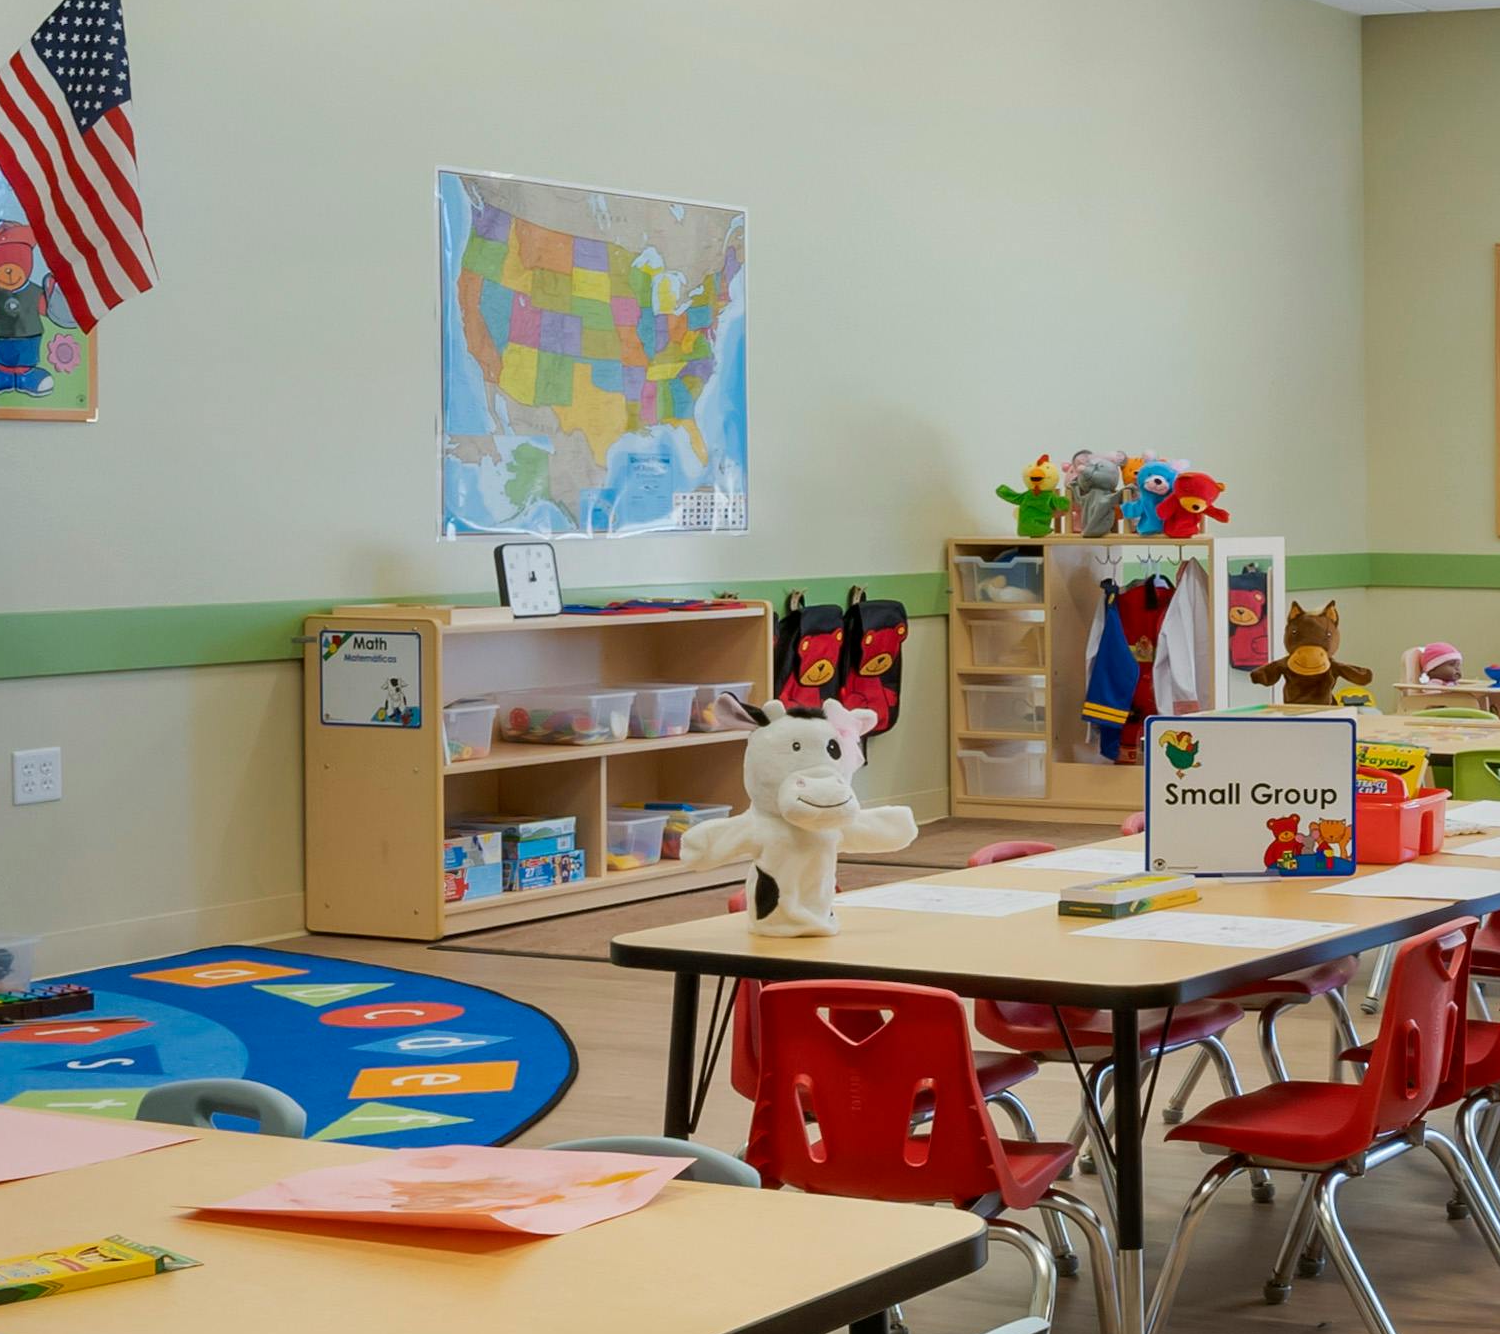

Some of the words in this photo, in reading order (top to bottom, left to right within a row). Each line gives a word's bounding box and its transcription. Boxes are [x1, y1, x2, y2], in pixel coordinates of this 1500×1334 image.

[353, 637, 387, 650] Math
[1165, 783, 1240, 805] Small
[1251, 783, 1337, 809] Group
[363, 1009, 425, 1020] c
[397, 1037, 486, 1051] d
[67, 1057, 134, 1072] s
[391, 1072, 461, 1087] e
[46, 1097, 127, 1111] t
[350, 1113, 443, 1125] f
